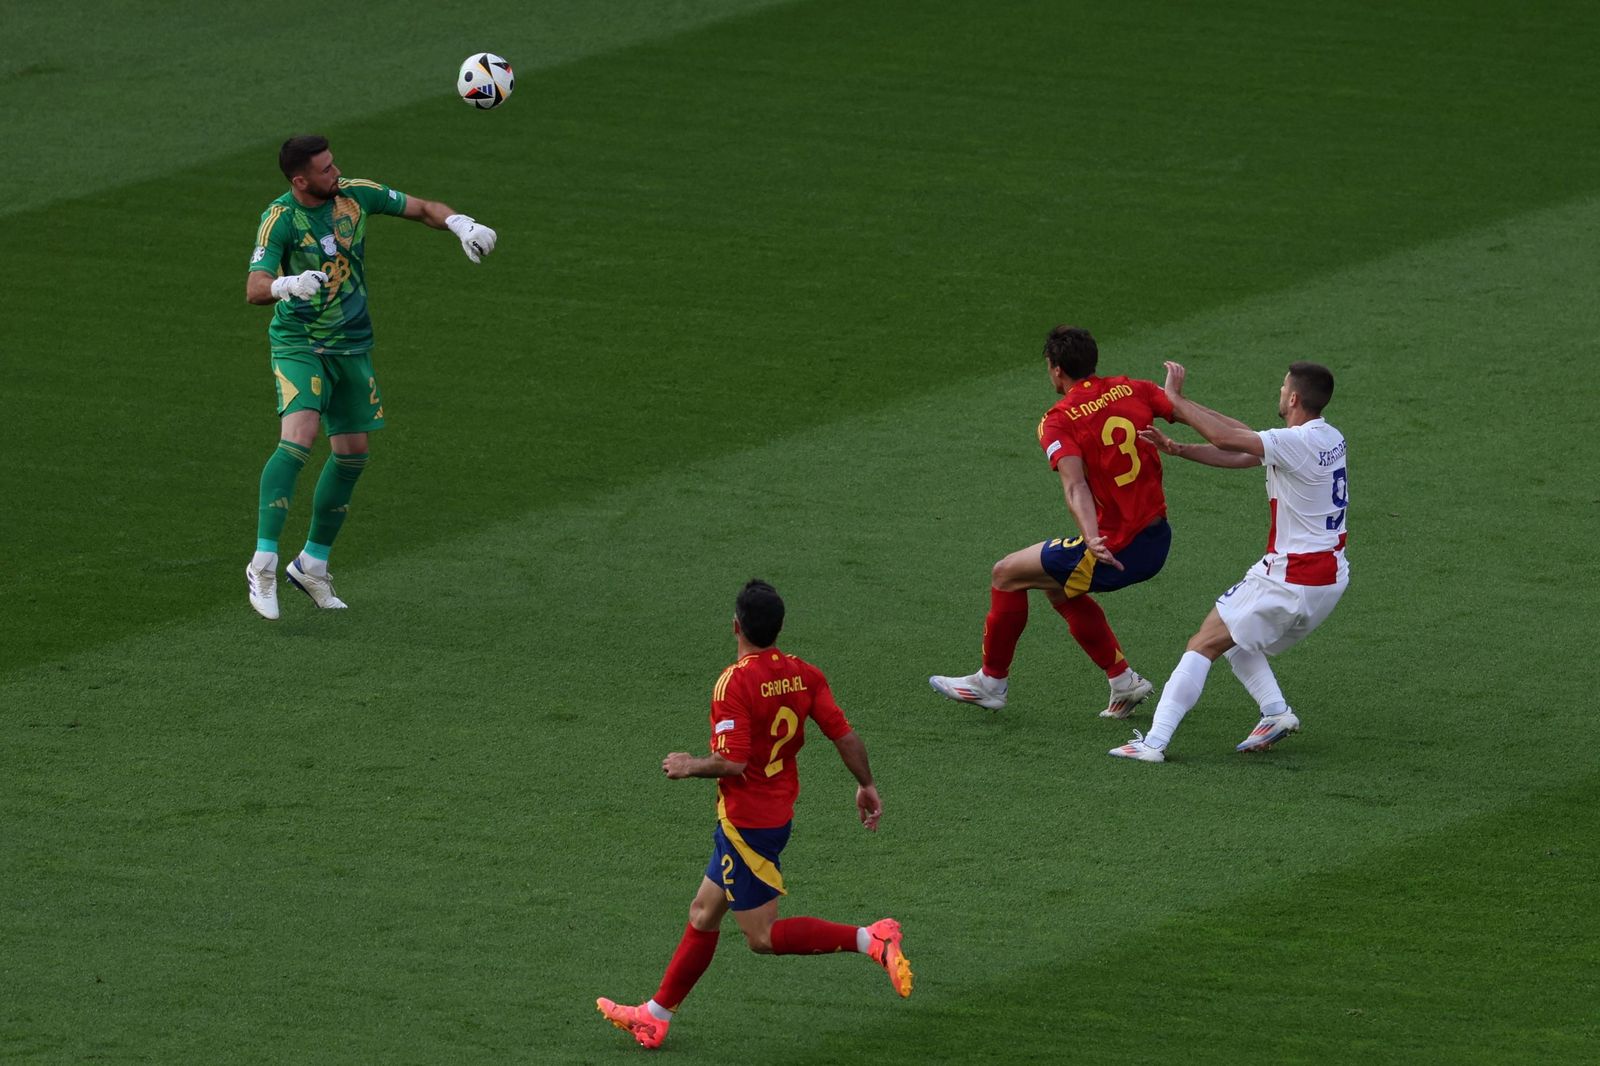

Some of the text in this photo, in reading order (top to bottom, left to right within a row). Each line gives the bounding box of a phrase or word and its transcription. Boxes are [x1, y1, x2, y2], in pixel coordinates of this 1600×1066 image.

[1064, 384, 1134, 421] LE NORMAND
[1101, 416, 1141, 488] 3
[1326, 467, 1348, 530] 9
[760, 675, 808, 698] CARVAJAL
[764, 705, 799, 778] 2
[721, 853, 735, 884] 2
